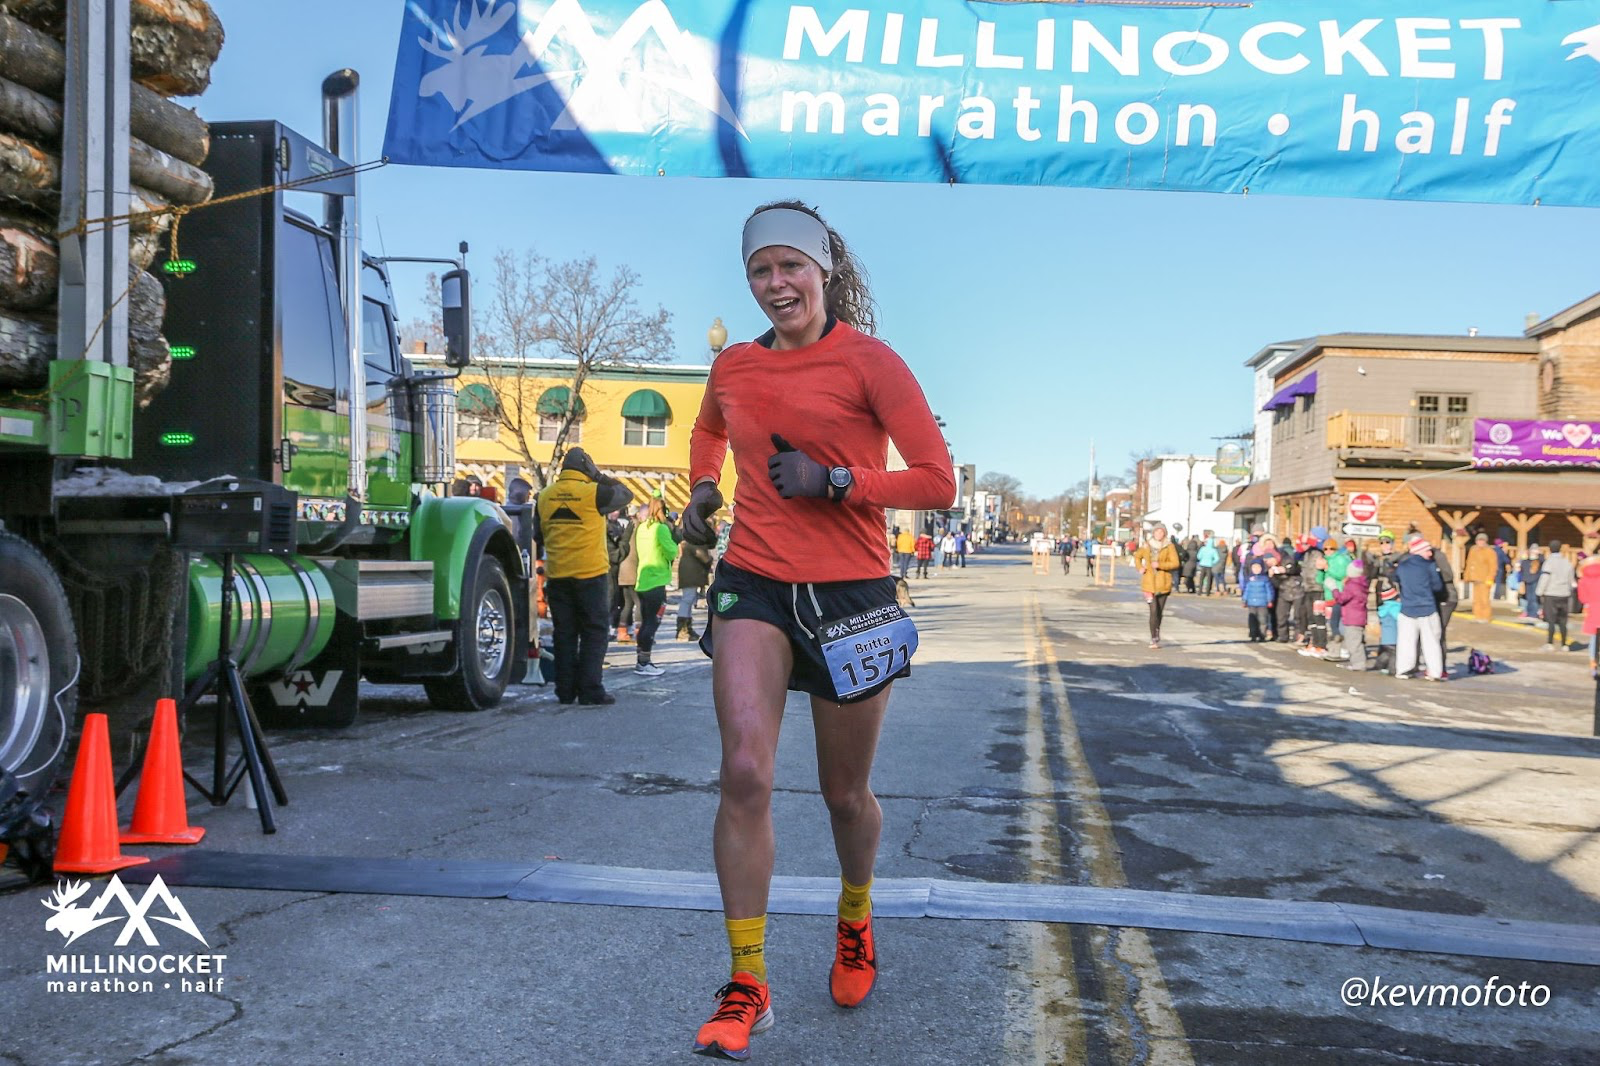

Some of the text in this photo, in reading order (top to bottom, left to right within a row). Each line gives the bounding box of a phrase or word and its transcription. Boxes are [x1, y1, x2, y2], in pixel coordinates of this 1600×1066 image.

[782, 5, 1522, 80] MILLINOCKET
[780, 84, 1516, 157] marathon half
[849, 605, 899, 625] MILLINOCKET
[851, 617, 884, 630] marathon
[855, 636, 891, 654] Britta
[841, 643, 909, 687] 1571
